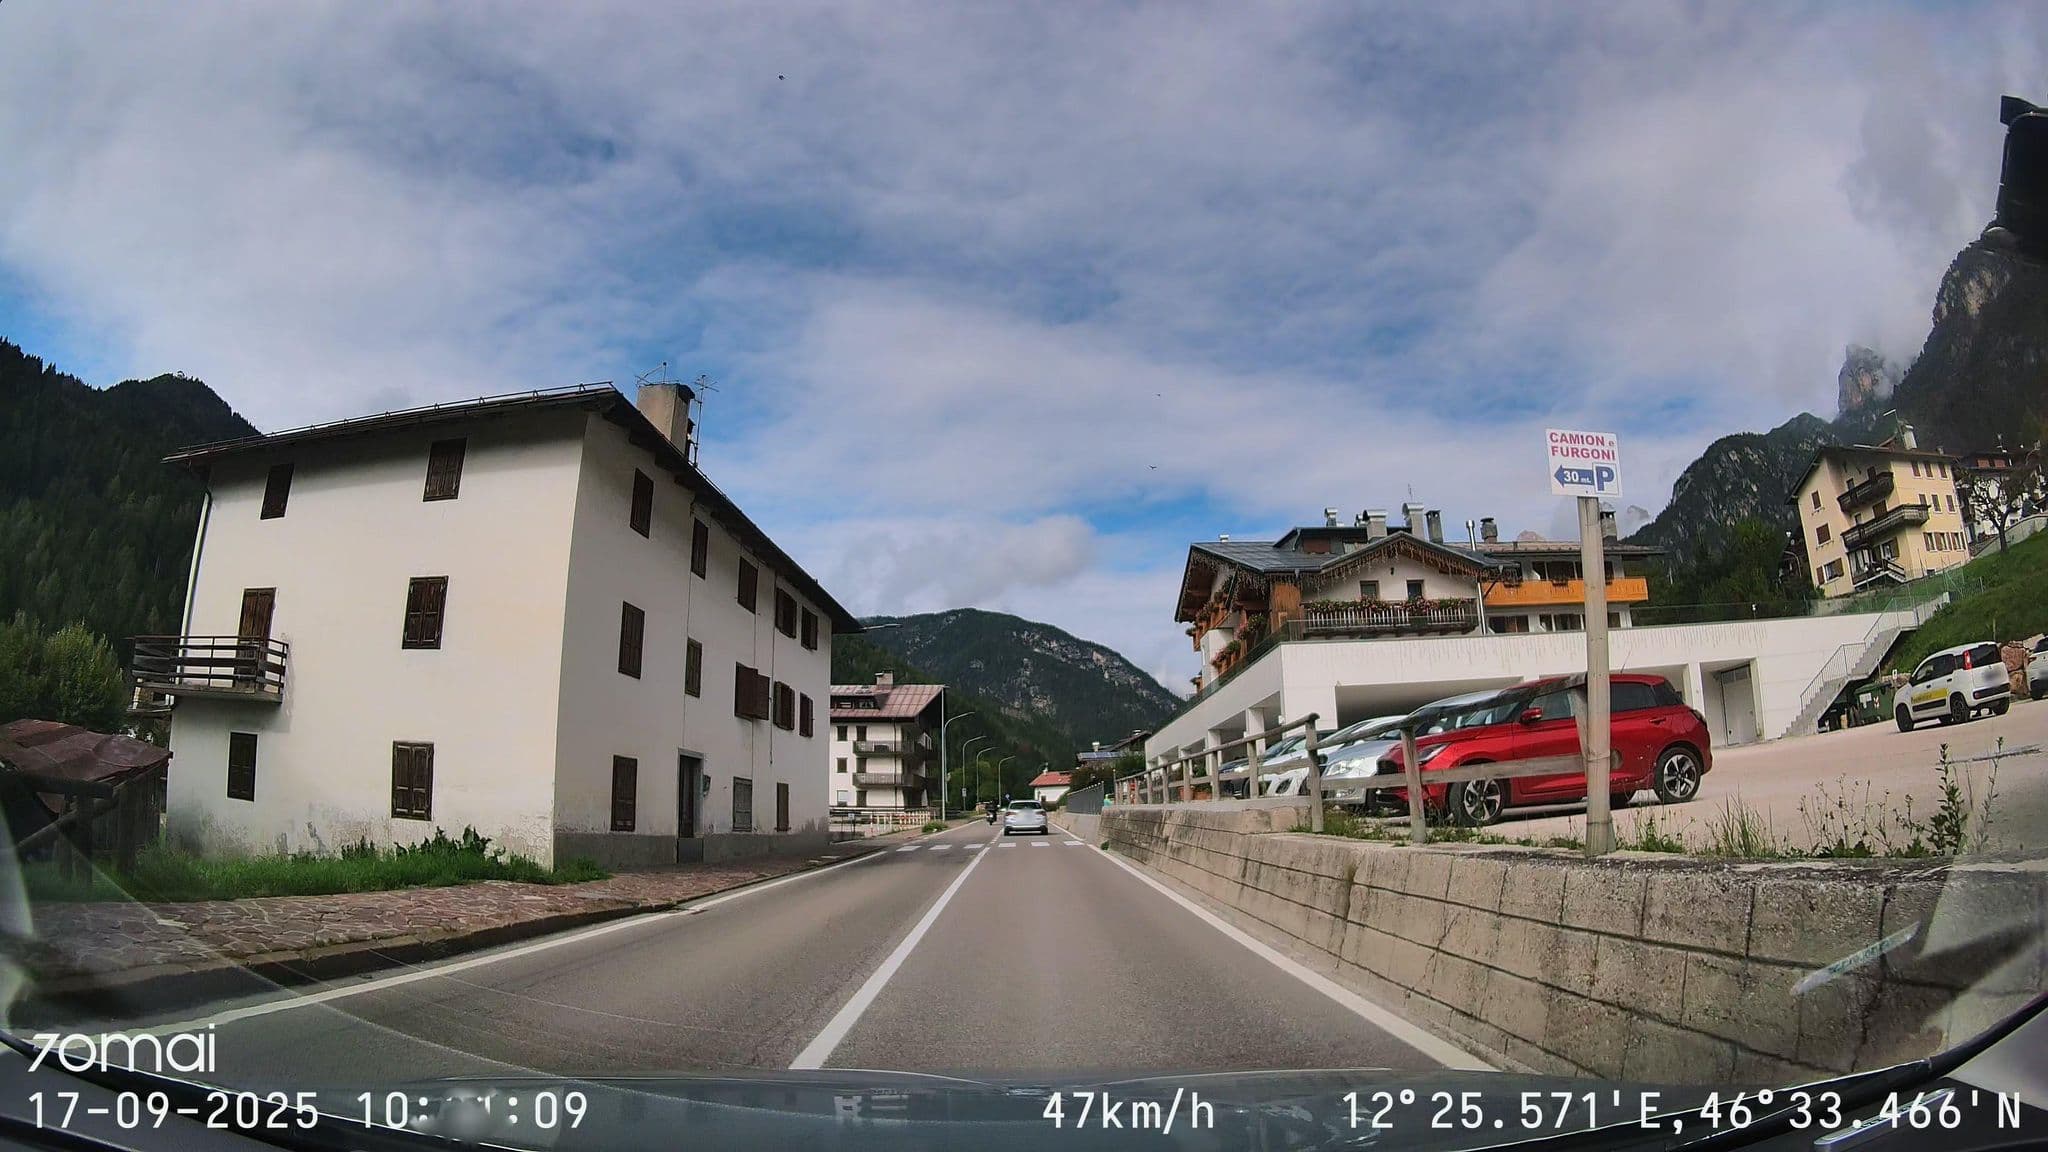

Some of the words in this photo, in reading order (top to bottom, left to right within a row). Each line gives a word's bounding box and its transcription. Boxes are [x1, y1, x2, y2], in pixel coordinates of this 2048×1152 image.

[1549, 432, 1605, 447] CAMION
[1551, 446, 1616, 461] FURGONI
[1563, 470, 1579, 483] 30
[1594, 465, 1615, 491] P
